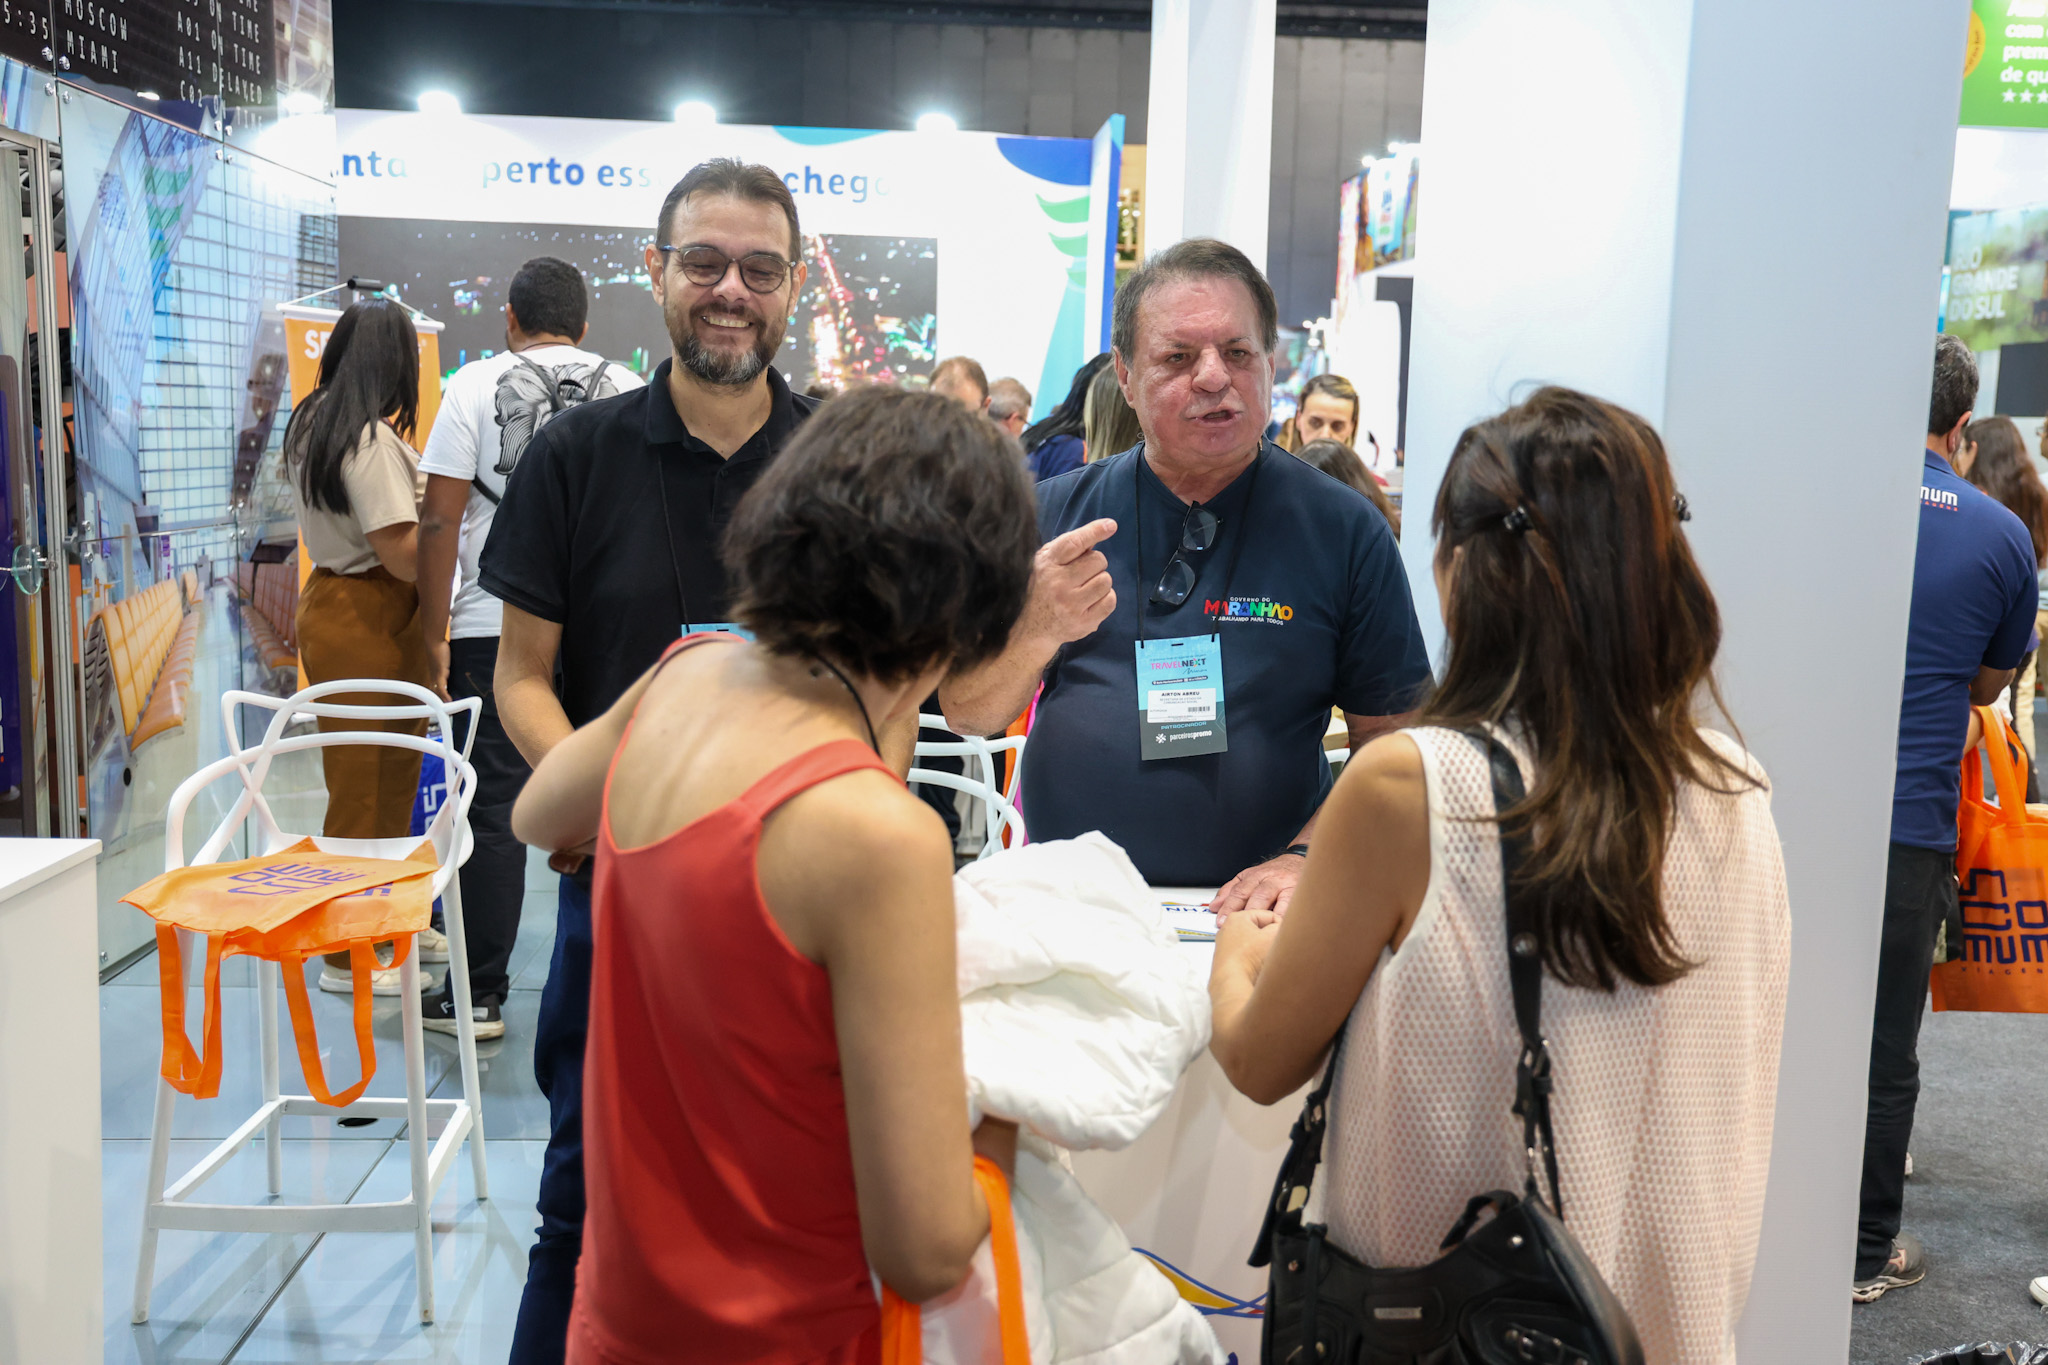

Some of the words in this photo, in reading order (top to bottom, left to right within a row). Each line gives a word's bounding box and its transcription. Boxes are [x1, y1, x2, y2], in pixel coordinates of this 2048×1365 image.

[64, 0, 128, 41] MOSCOW
[231, 10, 260, 43] TIME
[66, 29, 119, 74] MIAMI
[233, 43, 261, 75] TIME
[2000, 65, 2024, 83] de
[482, 157, 585, 189] perto
[1952, 265, 2021, 297] GRANDE
[1150, 658, 1207, 670] TRAVELNEXT
